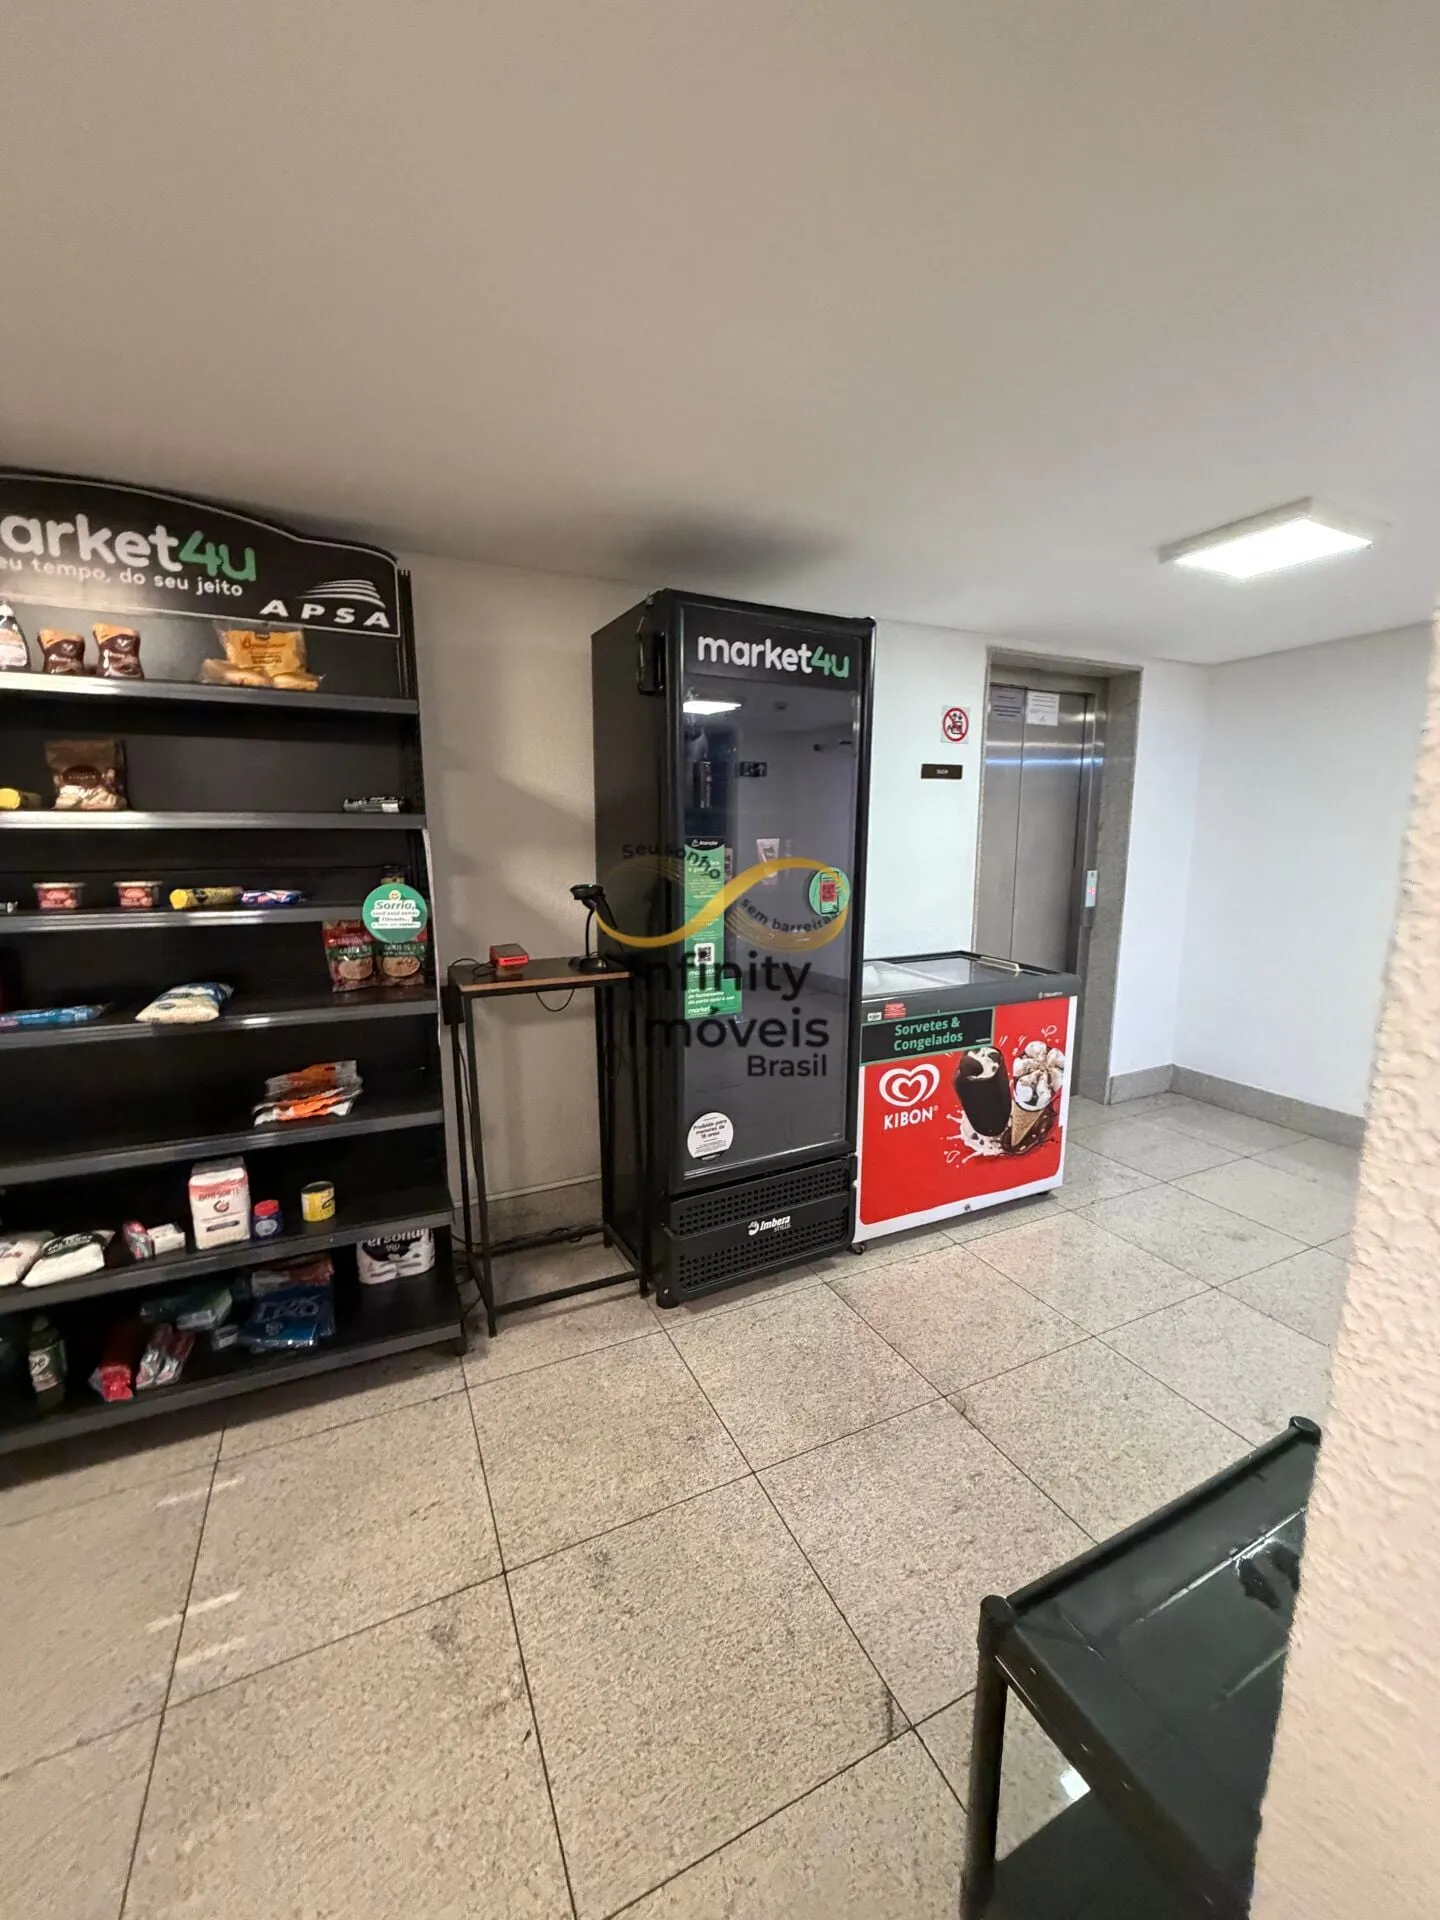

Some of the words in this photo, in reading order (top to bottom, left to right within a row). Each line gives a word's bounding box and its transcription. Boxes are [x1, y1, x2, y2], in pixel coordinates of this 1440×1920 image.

[31, 558, 112, 583] tempo,
[119, 567, 146, 585] do
[153, 575, 189, 591] seu
[195, 576, 243, 597] jeito
[259, 599, 391, 629] APSA
[697, 635, 850, 679] market4u
[894, 1019, 949, 1037] Sorvetes
[950, 1016, 961, 1029] &
[893, 1031, 963, 1051] Congelados
[760, 1215, 791, 1231] Imbera
